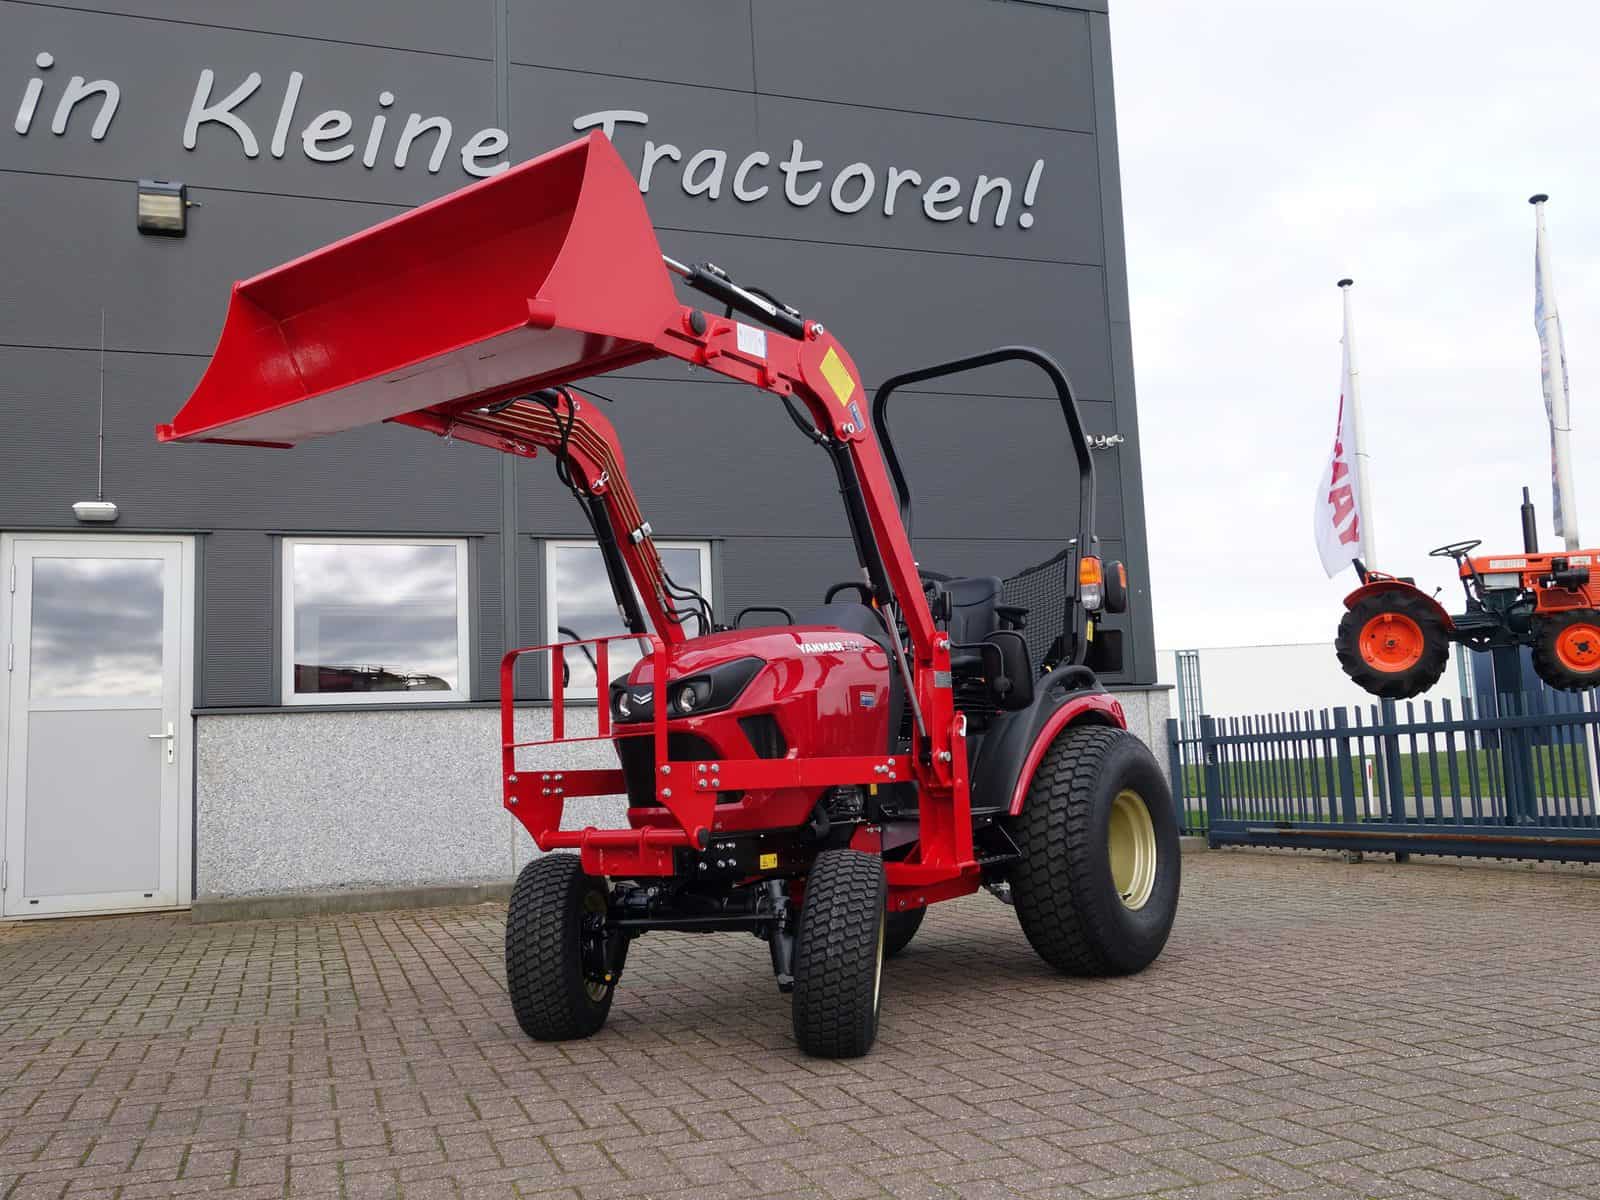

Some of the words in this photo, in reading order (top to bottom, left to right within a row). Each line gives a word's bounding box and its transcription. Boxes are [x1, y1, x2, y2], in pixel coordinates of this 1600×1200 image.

[14, 52, 121, 140] in
[182, 68, 511, 178] Kleine
[573, 109, 1046, 229] Tractoren!
[796, 641, 844, 654] YANMAR
